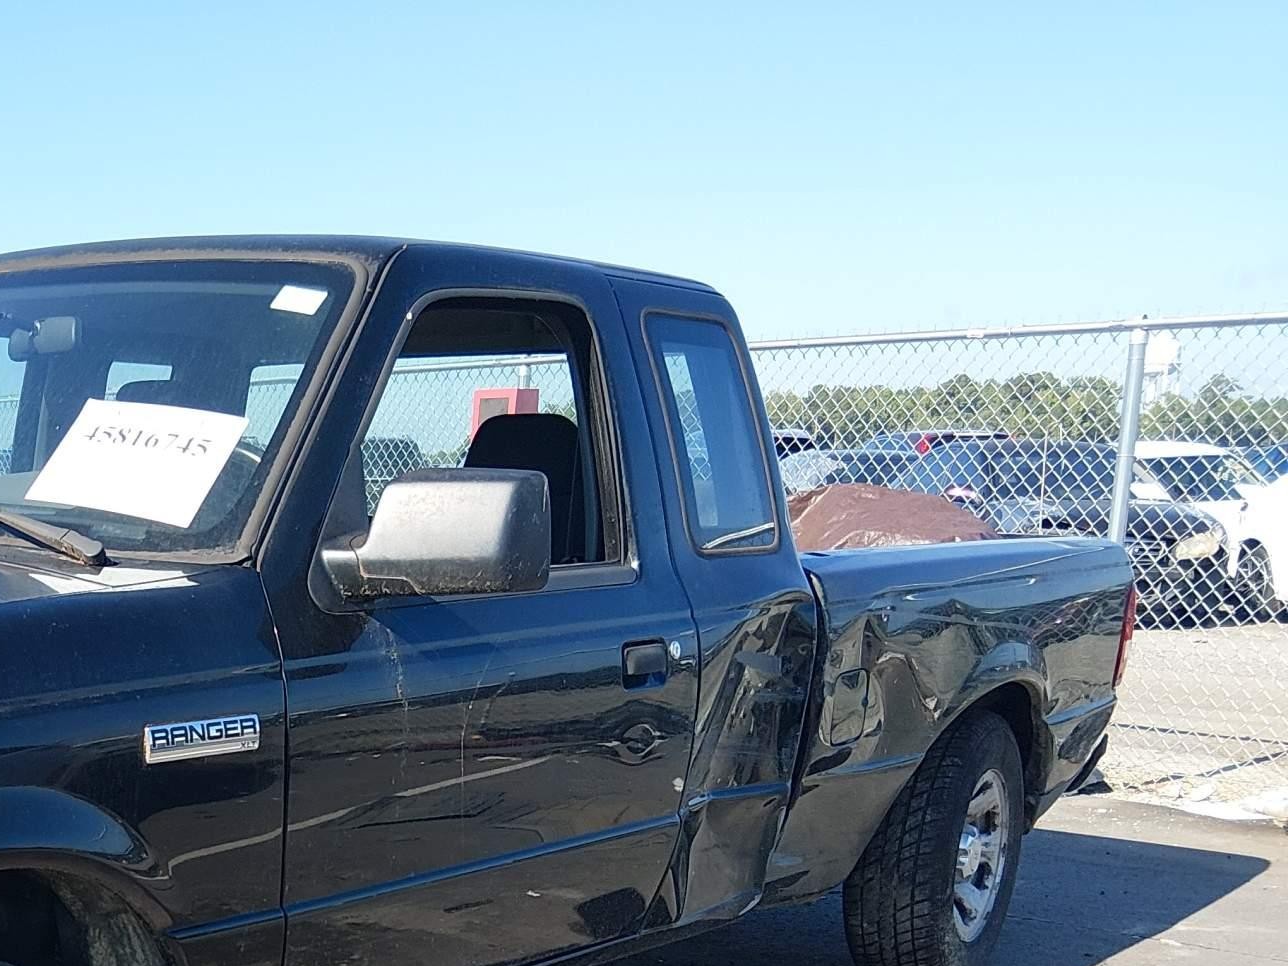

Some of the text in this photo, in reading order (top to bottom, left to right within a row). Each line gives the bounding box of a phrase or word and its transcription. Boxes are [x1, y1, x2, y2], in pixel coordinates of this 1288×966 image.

[83, 424, 215, 457] 45816745
[150, 717, 258, 748] RANGER
[239, 740, 257, 750] XLT
